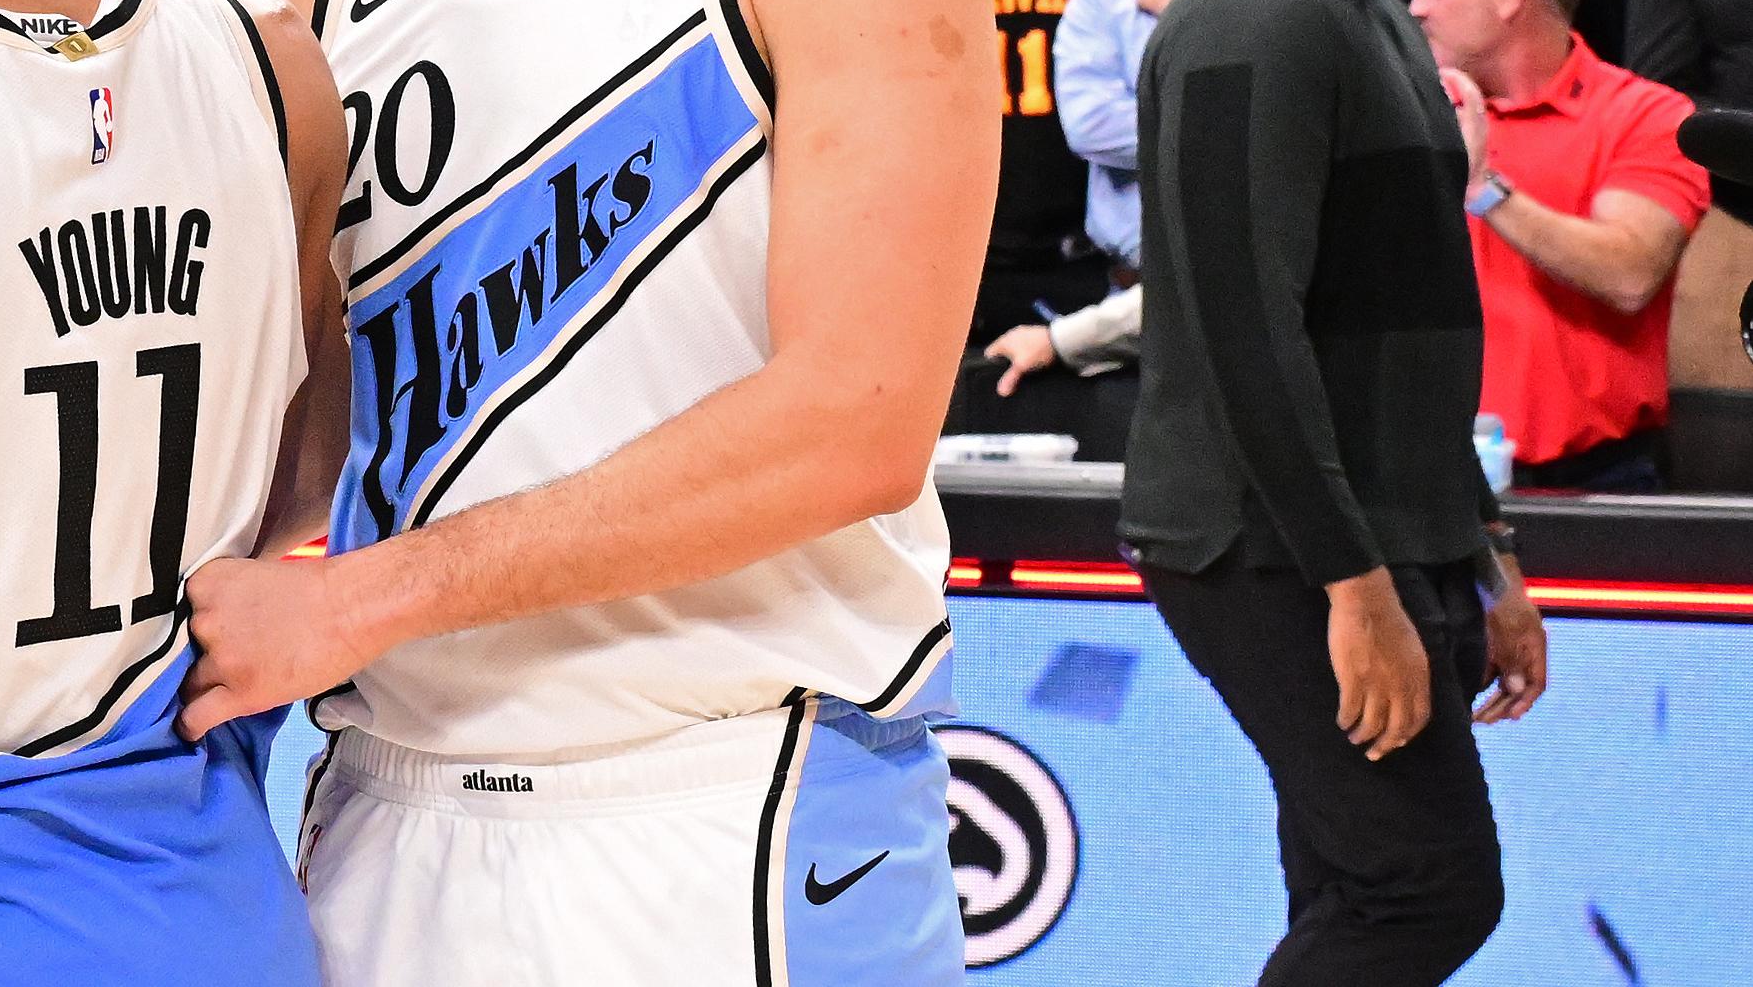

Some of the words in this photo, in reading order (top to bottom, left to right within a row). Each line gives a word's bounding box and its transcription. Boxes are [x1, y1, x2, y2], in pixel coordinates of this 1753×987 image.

[20, 18, 79, 36] NIKE
[18, 206, 211, 338] YOUNG
[357, 140, 655, 542] Hawks
[15, 343, 201, 648] 11
[462, 769, 534, 792] atlanta
